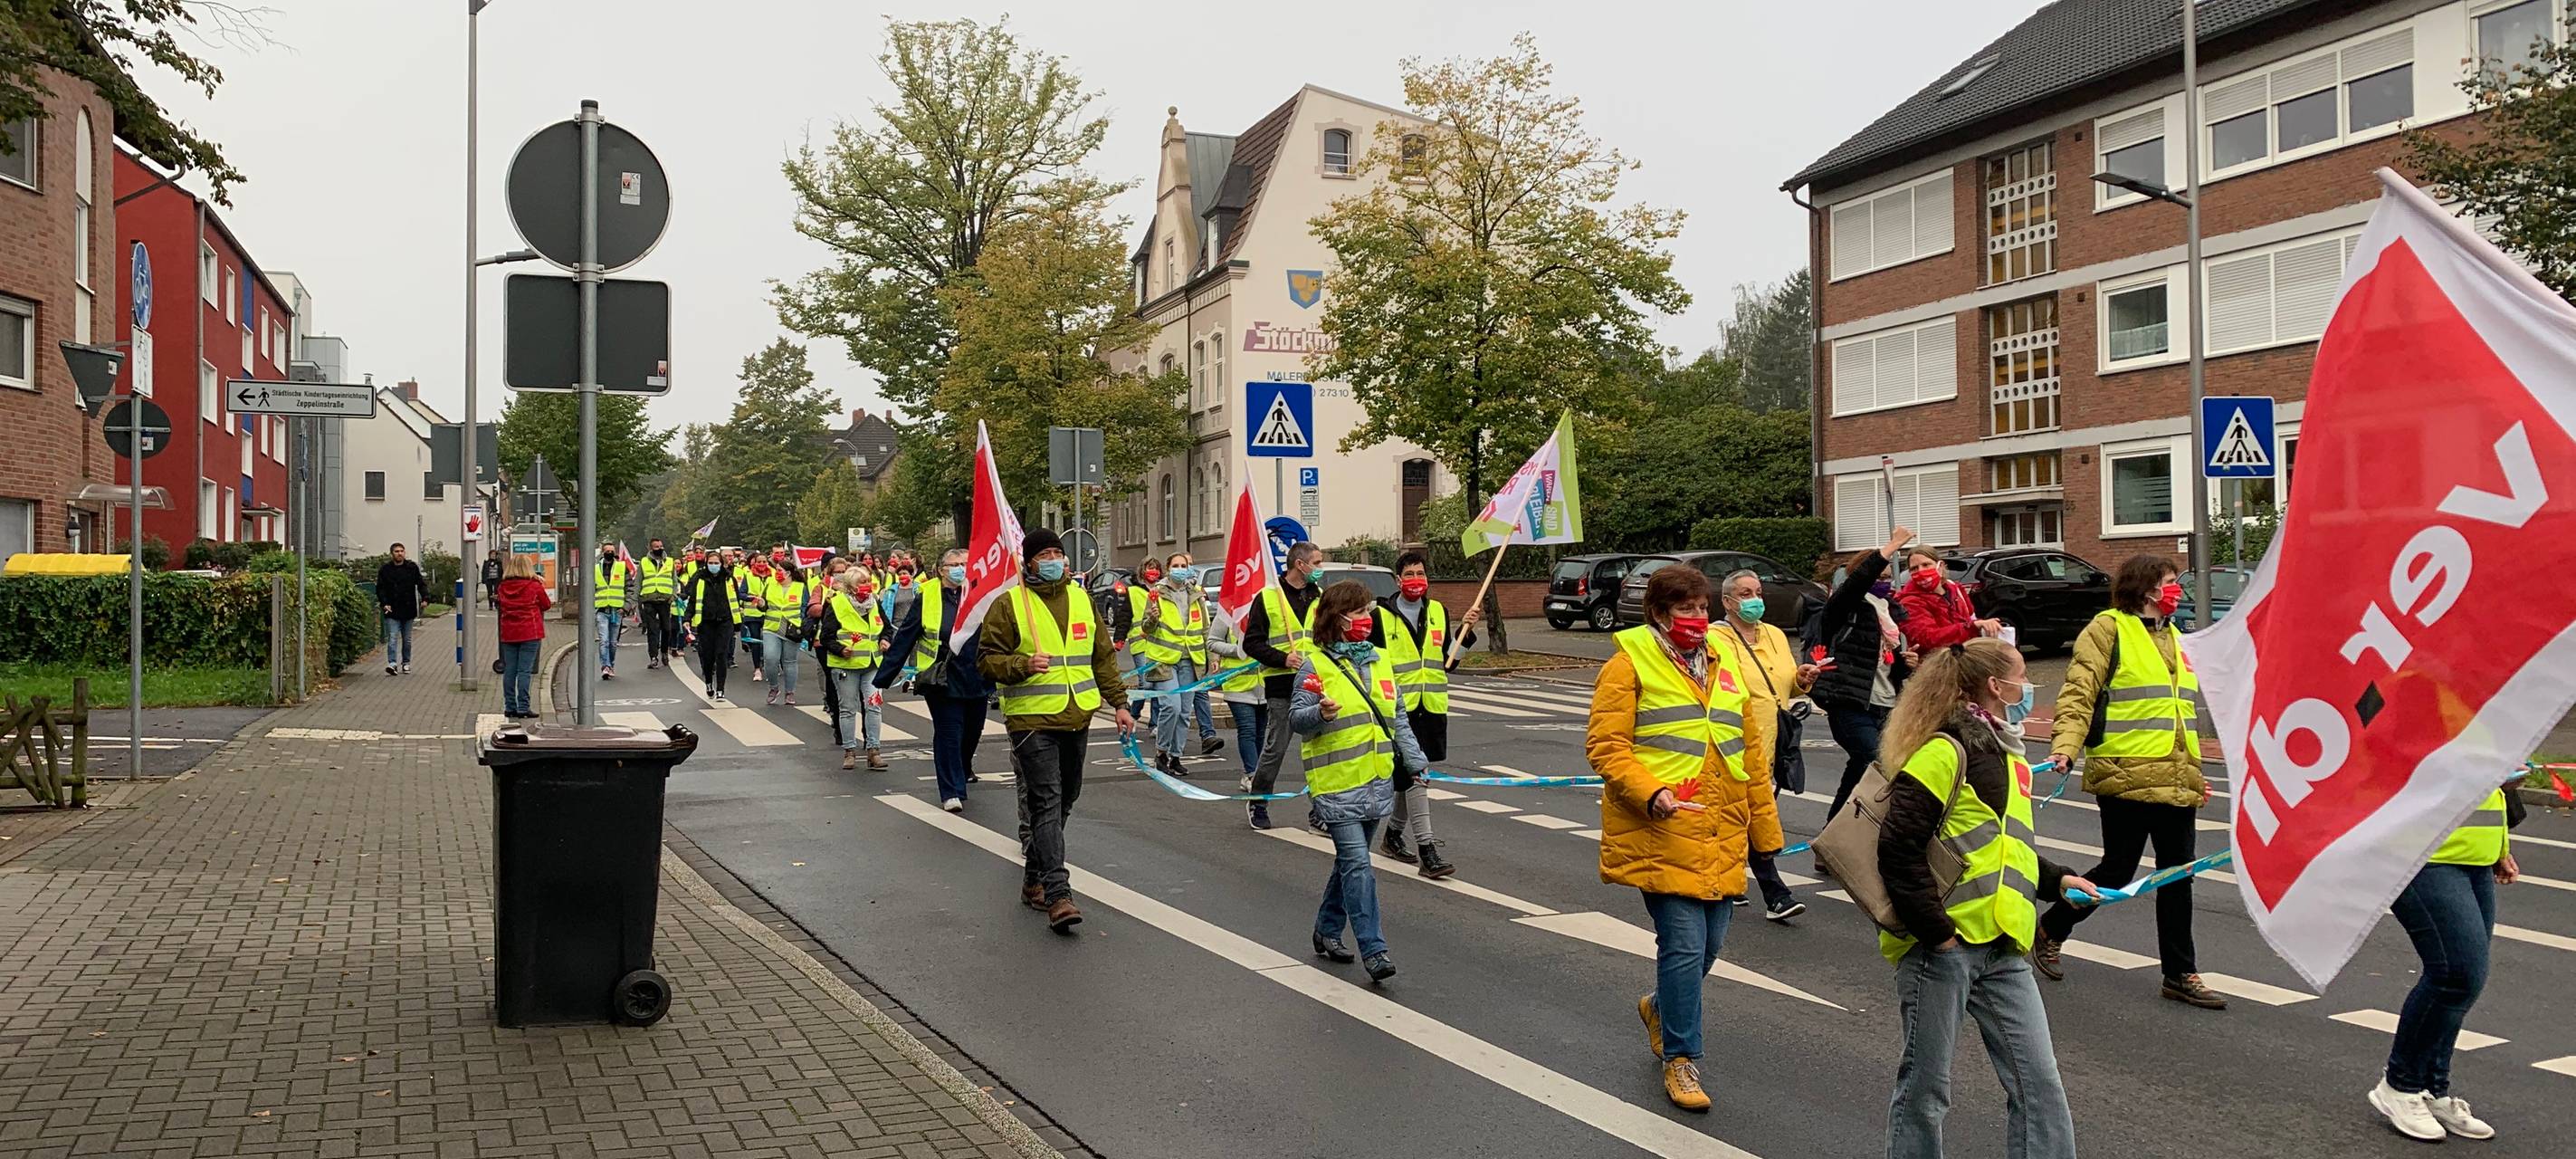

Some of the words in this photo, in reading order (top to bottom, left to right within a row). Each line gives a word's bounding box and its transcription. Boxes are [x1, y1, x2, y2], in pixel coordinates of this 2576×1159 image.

[272, 389, 301, 398] Städtische
[303, 390, 368, 401] Kindertageseinrichtung
[1320, 388, 1350, 398] 27310
[296, 399, 345, 408] Zeppelinstraße
[1302, 469, 1313, 484] P
